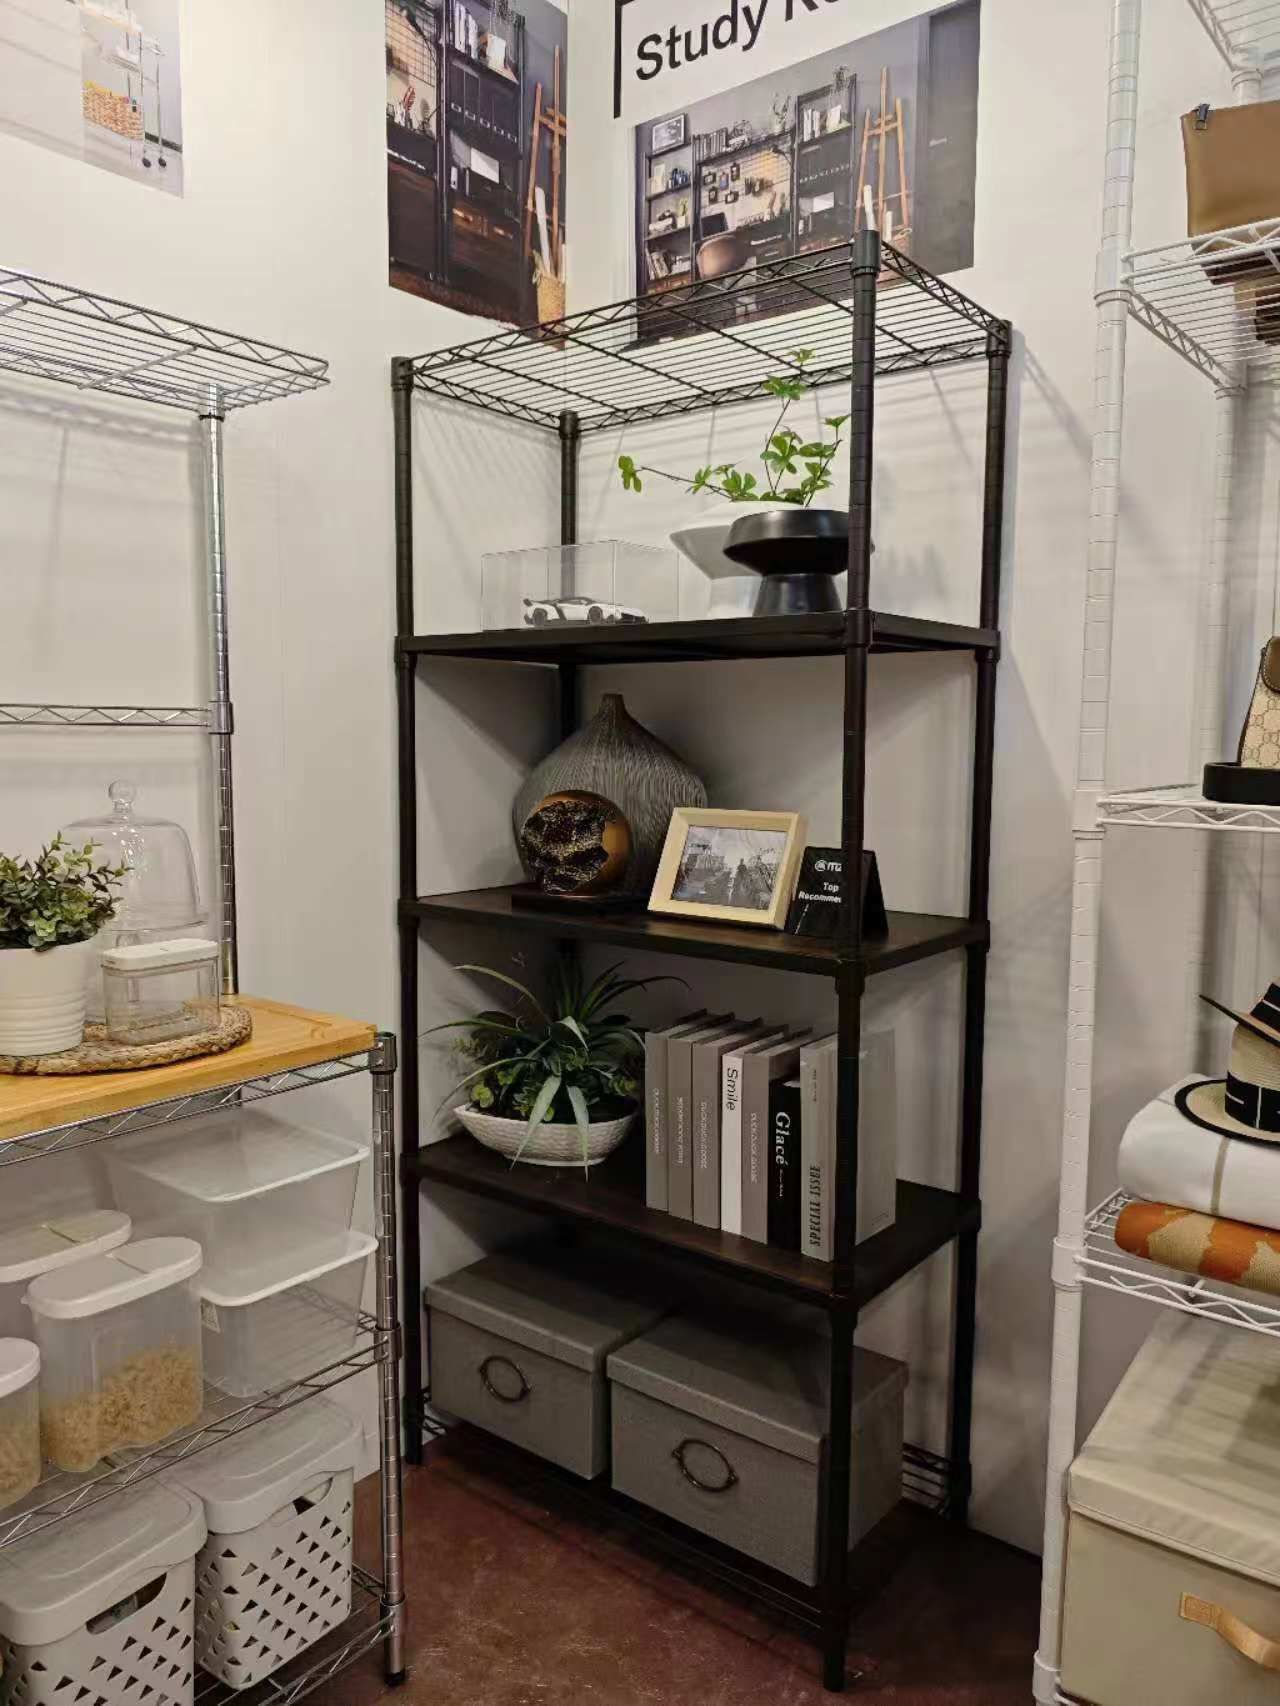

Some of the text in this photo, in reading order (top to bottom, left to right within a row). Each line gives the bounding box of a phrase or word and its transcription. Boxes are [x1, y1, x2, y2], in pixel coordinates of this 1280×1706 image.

[636, 0, 768, 81] Study
[823, 881, 839, 893] Top
[726, 1067, 738, 1111] Smile
[775, 1111, 791, 1166] Glacé
[809, 1201, 821, 1247] SPECIAL
